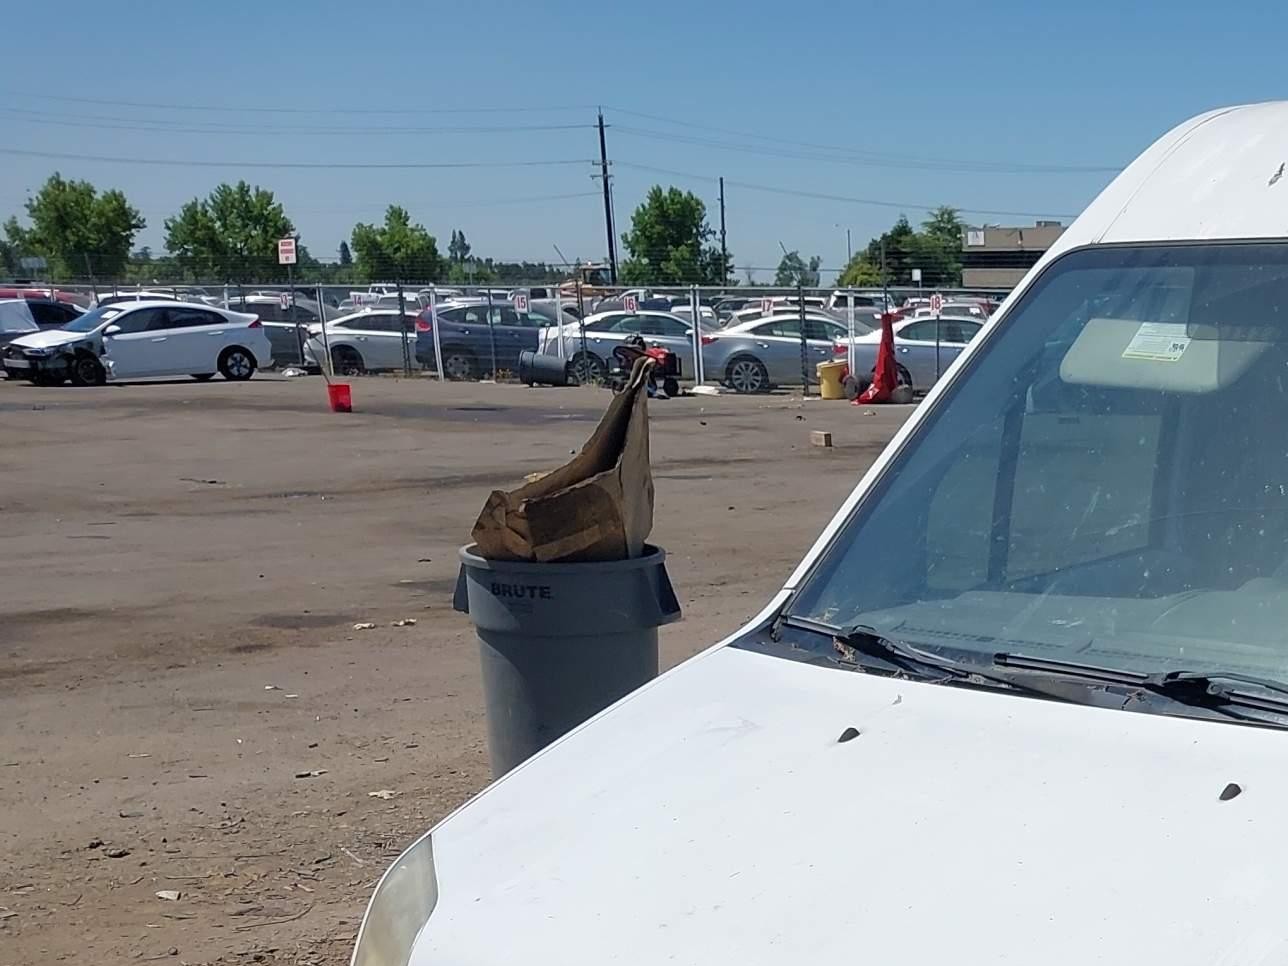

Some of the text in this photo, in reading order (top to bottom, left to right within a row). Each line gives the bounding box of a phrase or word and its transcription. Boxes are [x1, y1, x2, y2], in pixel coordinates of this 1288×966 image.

[516, 295, 527, 309] 15
[624, 296, 635, 310] 16
[930, 297, 941, 310] 18
[490, 582, 551, 599] BRUTE
